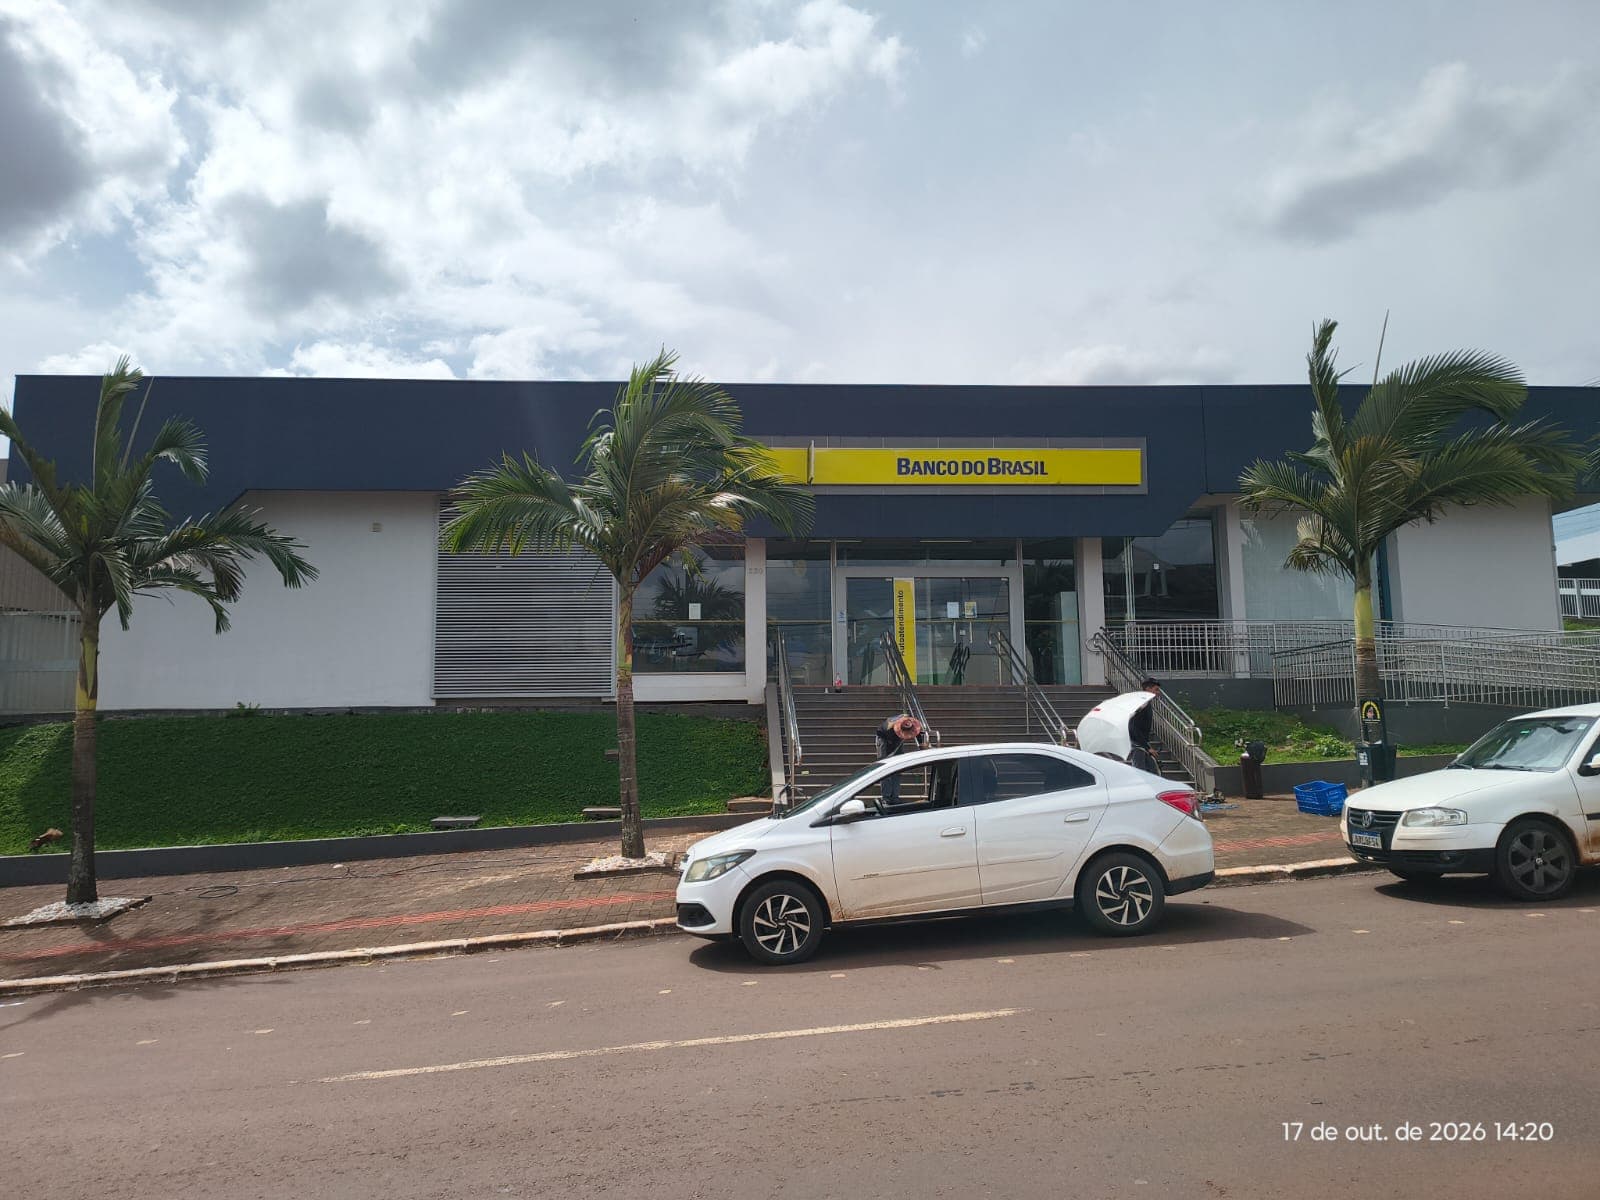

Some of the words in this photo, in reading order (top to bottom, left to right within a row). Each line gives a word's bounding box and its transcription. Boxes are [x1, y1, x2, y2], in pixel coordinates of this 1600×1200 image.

[897, 458, 958, 475] BANCO
[961, 460, 985, 475] DO
[987, 457, 1048, 475] BRASIL
